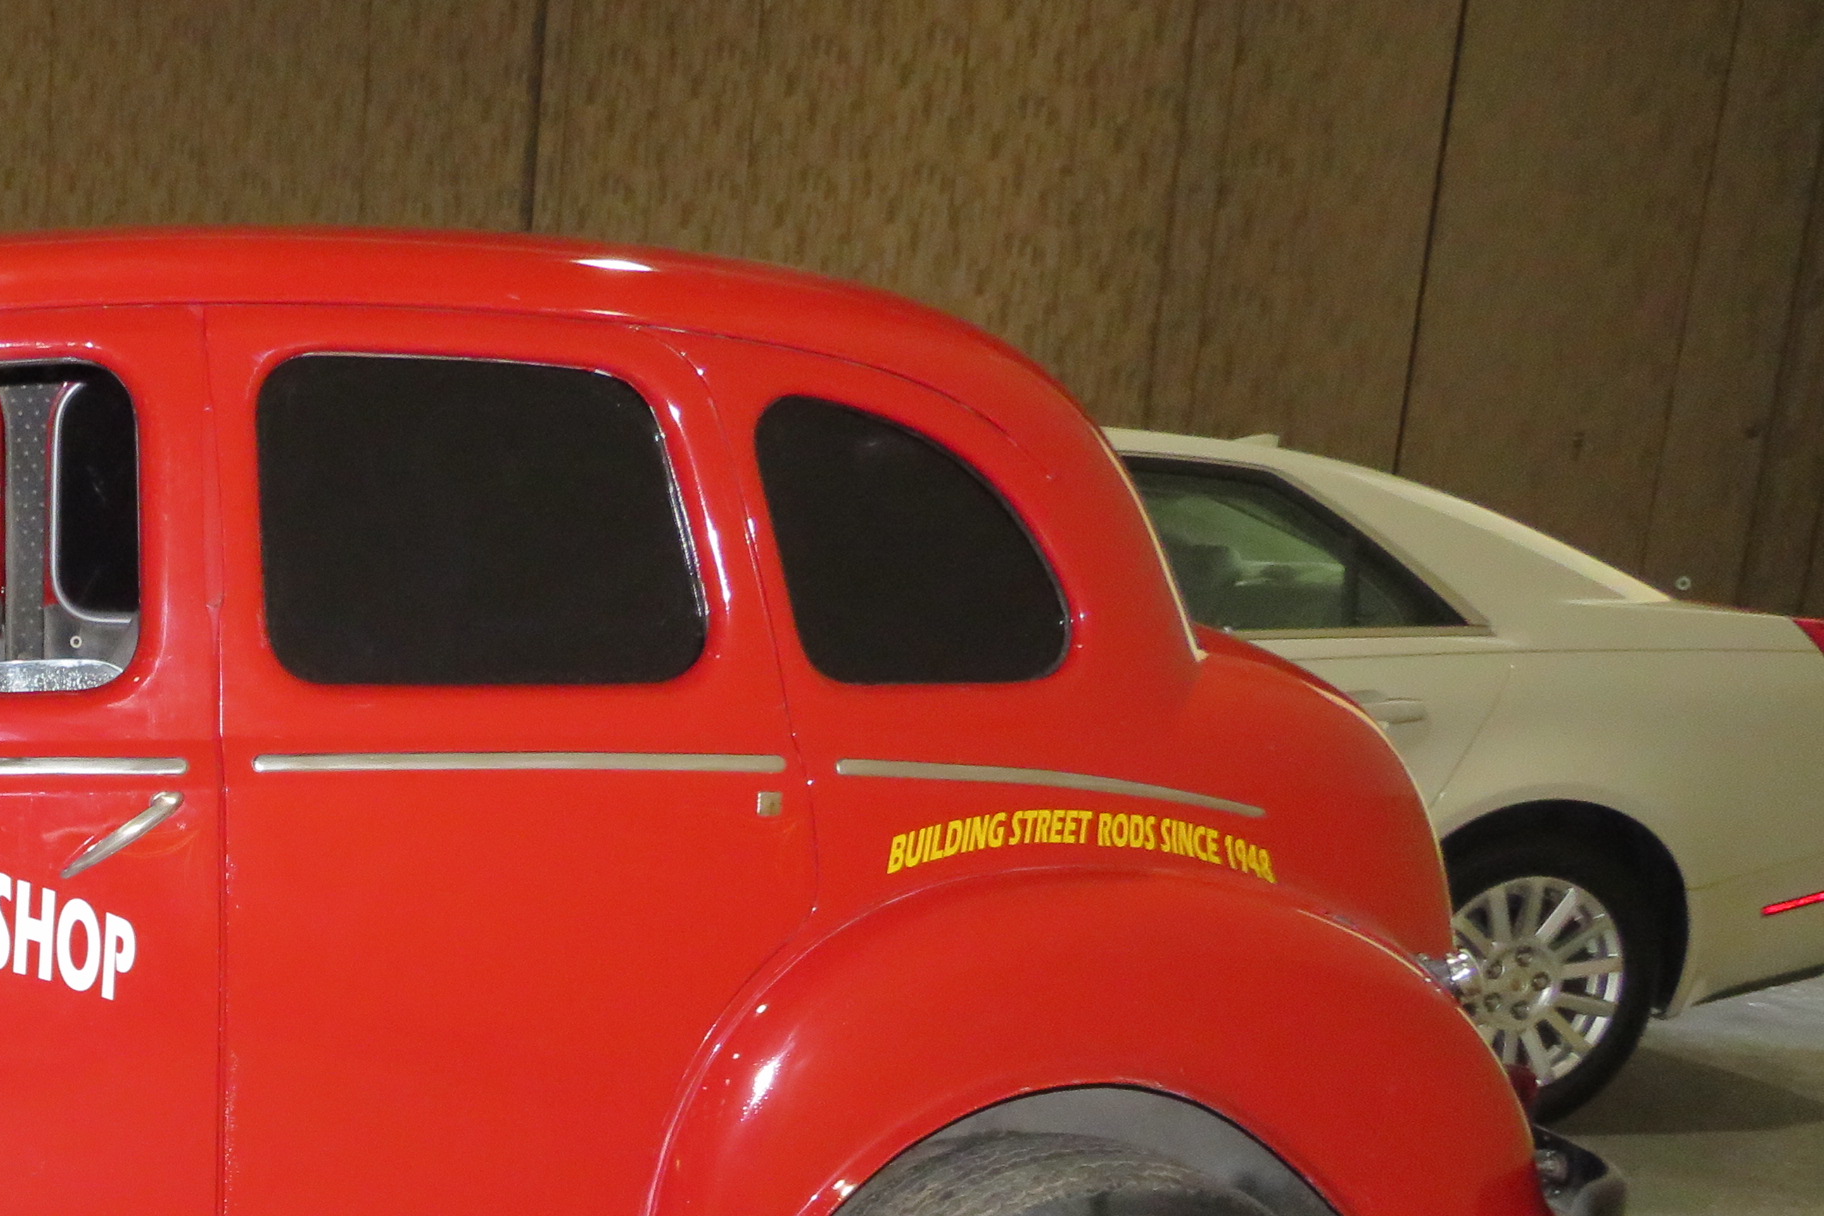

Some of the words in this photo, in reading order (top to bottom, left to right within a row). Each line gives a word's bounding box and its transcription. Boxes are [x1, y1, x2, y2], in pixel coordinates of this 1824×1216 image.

[887, 812, 1005, 874] BUILDING
[1008, 809, 1093, 845] STREET
[1097, 812, 1156, 850] RODS
[1160, 819, 1222, 864] SINCE
[1224, 834, 1277, 883] 1948
